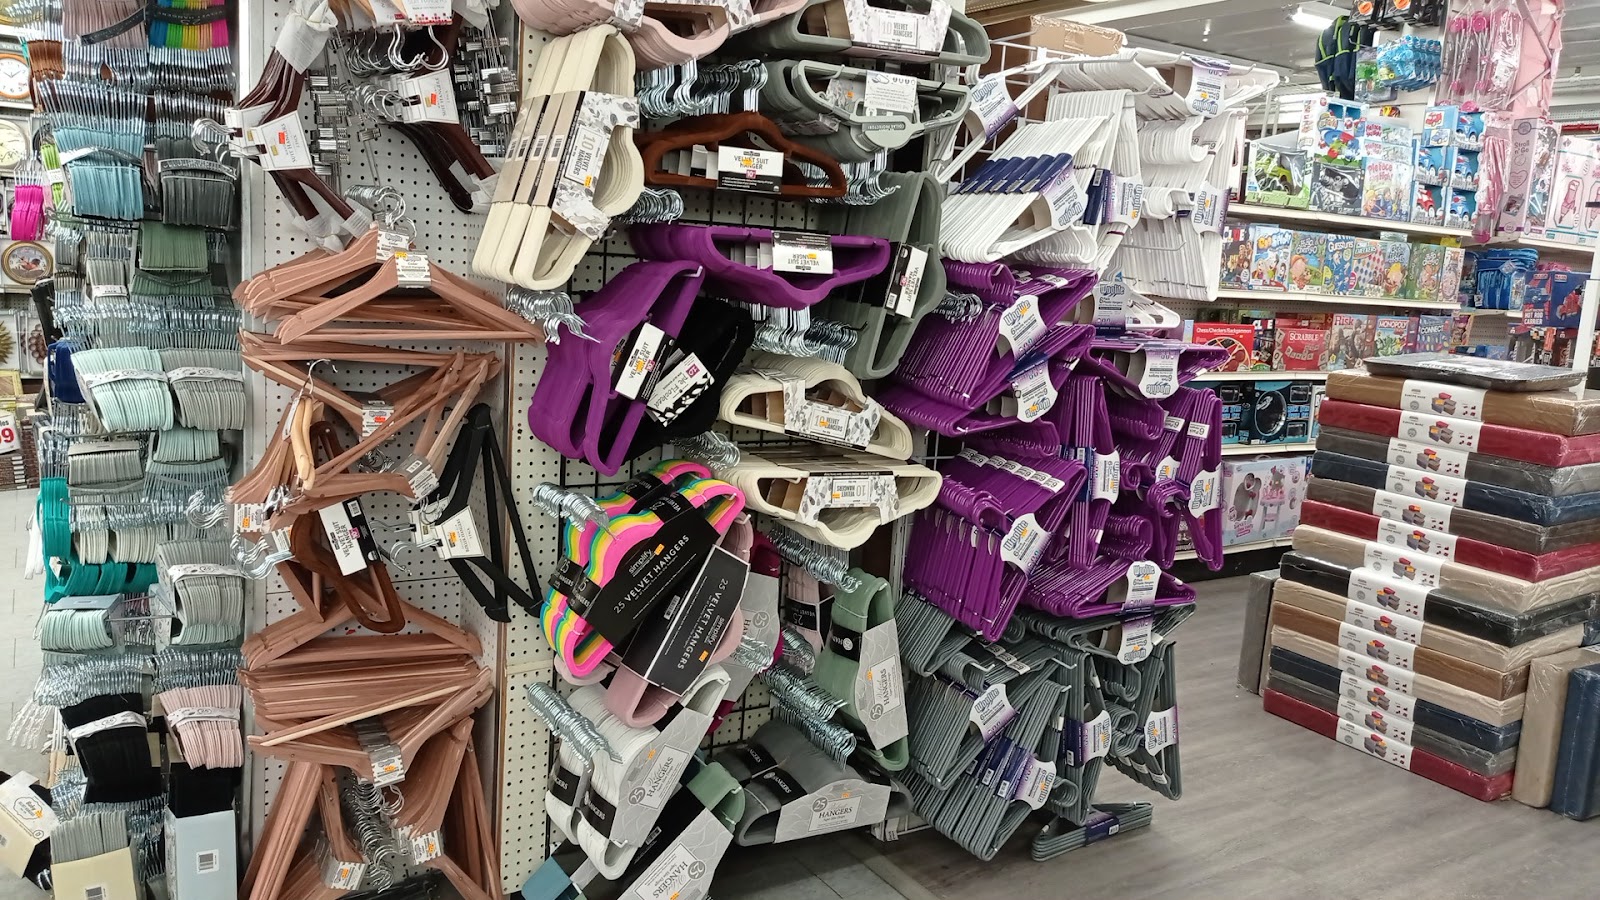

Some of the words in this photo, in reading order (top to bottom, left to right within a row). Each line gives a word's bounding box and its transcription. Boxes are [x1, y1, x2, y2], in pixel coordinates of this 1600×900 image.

[1514, 140, 1530, 148] Stroll
[1100, 284, 1125, 297] Woolite
[1334, 316, 1354, 326] Risk
[1379, 320, 1408, 328] MONOPOLY
[1289, 332, 1319, 341] SCRABBLE
[1421, 325, 1444, 334] CONNECT
[338, 535, 351, 558] VELVET
[628, 548, 653, 573] simplify
[613, 601, 626, 614] 25
[624, 571, 654, 603] VELVET
[652, 534, 690, 573] HANGERS
[718, 578, 729, 590] 25
[696, 592, 722, 627] VELVET
[708, 617, 725, 646] simplify
[677, 628, 701, 670] HANGERS
[880, 668, 889, 705] HANGERS
[870, 705, 883, 719] 25
[630, 788, 645, 803] 25
[646, 756, 673, 797] HANGERS
[813, 799, 827, 811] 25
[818, 806, 853, 819] HANGERS
[689, 862, 705, 878] 25
[653, 861, 688, 898] HANGERS
